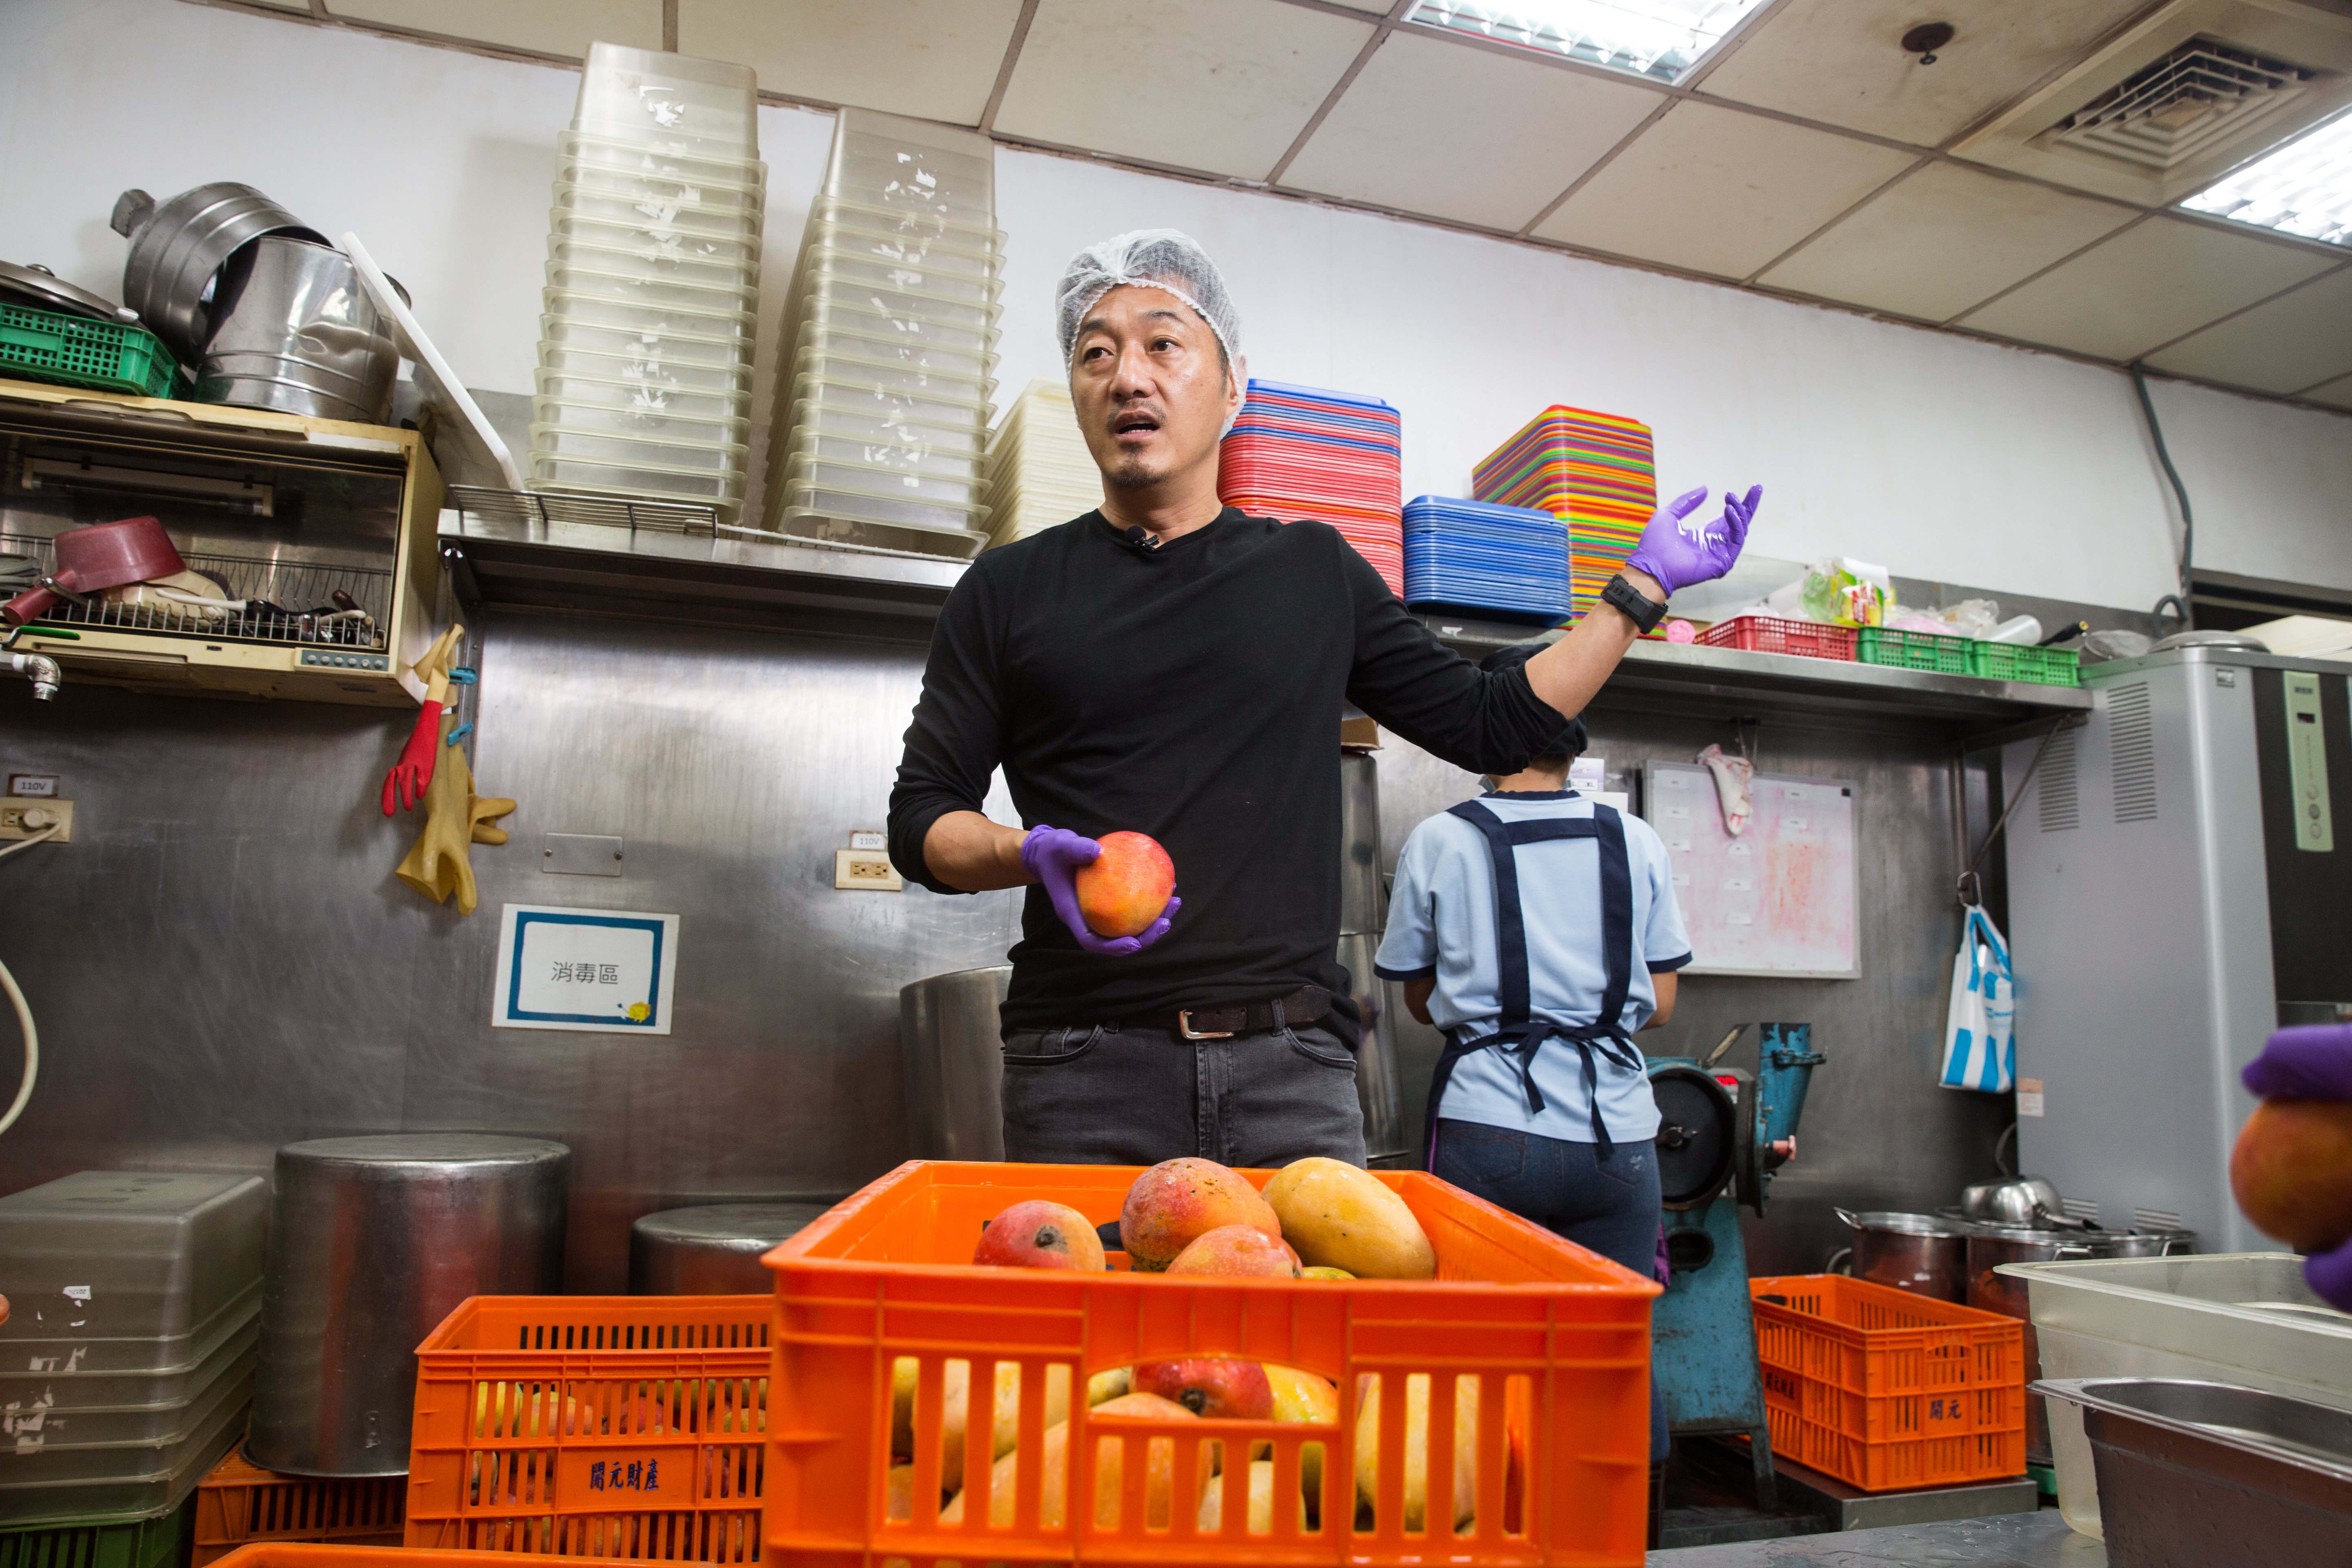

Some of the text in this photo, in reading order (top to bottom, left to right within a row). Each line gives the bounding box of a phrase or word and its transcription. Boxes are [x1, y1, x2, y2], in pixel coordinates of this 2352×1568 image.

[21, 782, 47, 791] 110V
[551, 961, 619, 984] 消毒區
[1930, 1399, 1962, 1420] 開元
[590, 1458, 659, 1492] 開元財產
